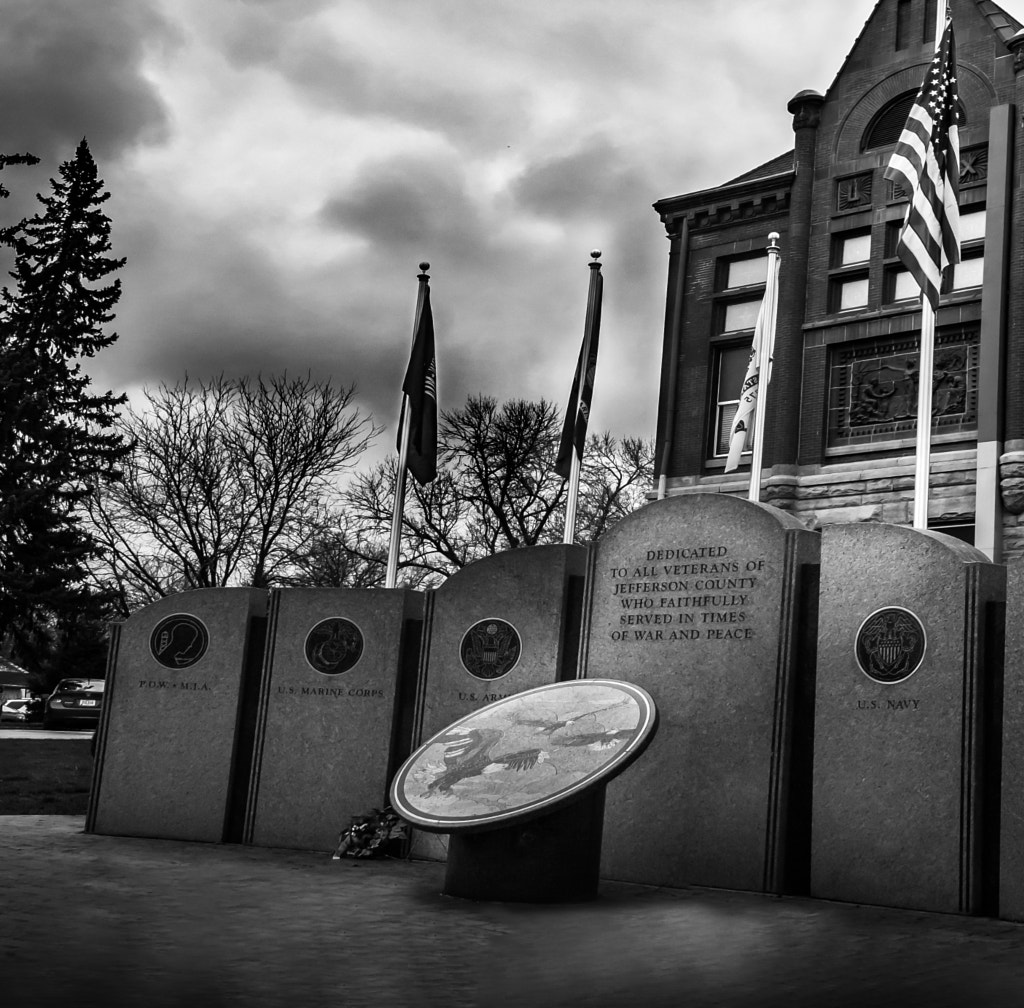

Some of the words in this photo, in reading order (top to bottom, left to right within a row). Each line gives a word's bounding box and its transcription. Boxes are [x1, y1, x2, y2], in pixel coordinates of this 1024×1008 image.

[646, 546, 728, 561] DEDICATED
[611, 567, 628, 578] TO
[633, 566, 658, 578] ALL
[664, 562, 739, 575] VETERANS
[746, 560, 765, 571] OF
[613, 580, 689, 595] JEFFERSON
[695, 577, 757, 591] COUNTY
[621, 598, 654, 609] WHO
[660, 594, 748, 608] FAITHFULLY
[620, 614, 673, 625] SERVED
[679, 613, 694, 624] IN
[701, 611, 746, 623] TIMES
[611, 630, 629, 641] OF
[634, 630, 663, 641] WAR
[669, 629, 700, 641] AND
[707, 628, 753, 640] PEACE
[278, 686, 296, 695] U.S.
[301, 687, 344, 698] MARINE
[348, 688, 384, 697] CORPS
[459, 692, 477, 701] U.S.
[482, 693, 511, 702] ARM
[857, 700, 880, 710] U.S.
[887, 699, 920, 710] NAVY
